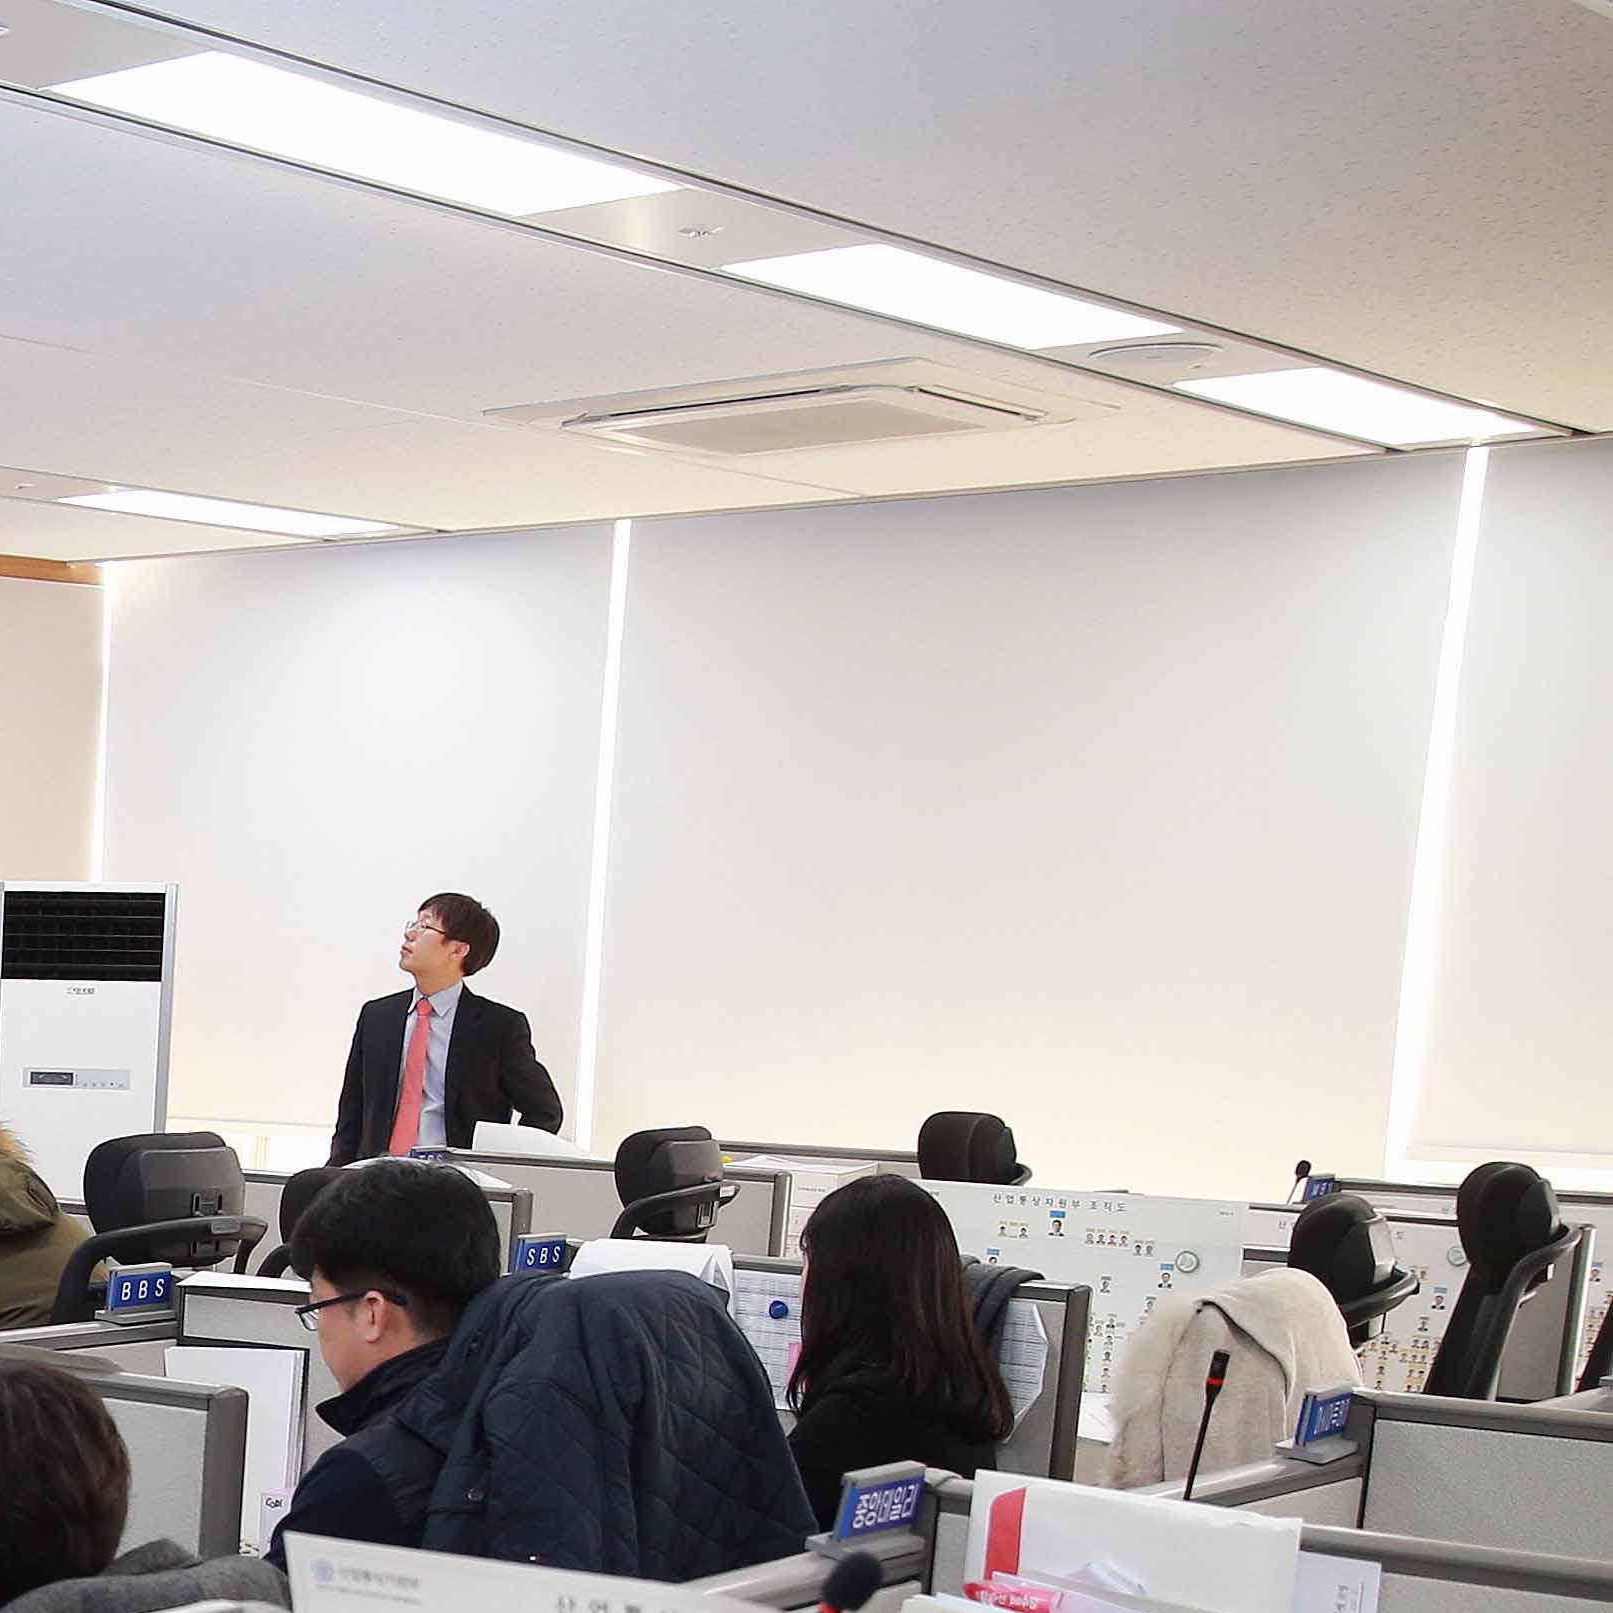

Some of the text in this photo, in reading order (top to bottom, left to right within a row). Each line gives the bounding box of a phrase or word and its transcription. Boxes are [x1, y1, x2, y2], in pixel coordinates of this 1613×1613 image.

[993, 1193, 1127, 1213] 산업통상자원부 조직도
[526, 1245, 562, 1266] SBS
[121, 1278, 165, 1301] BBS
[852, 1483, 919, 1529] 중앙데일리
